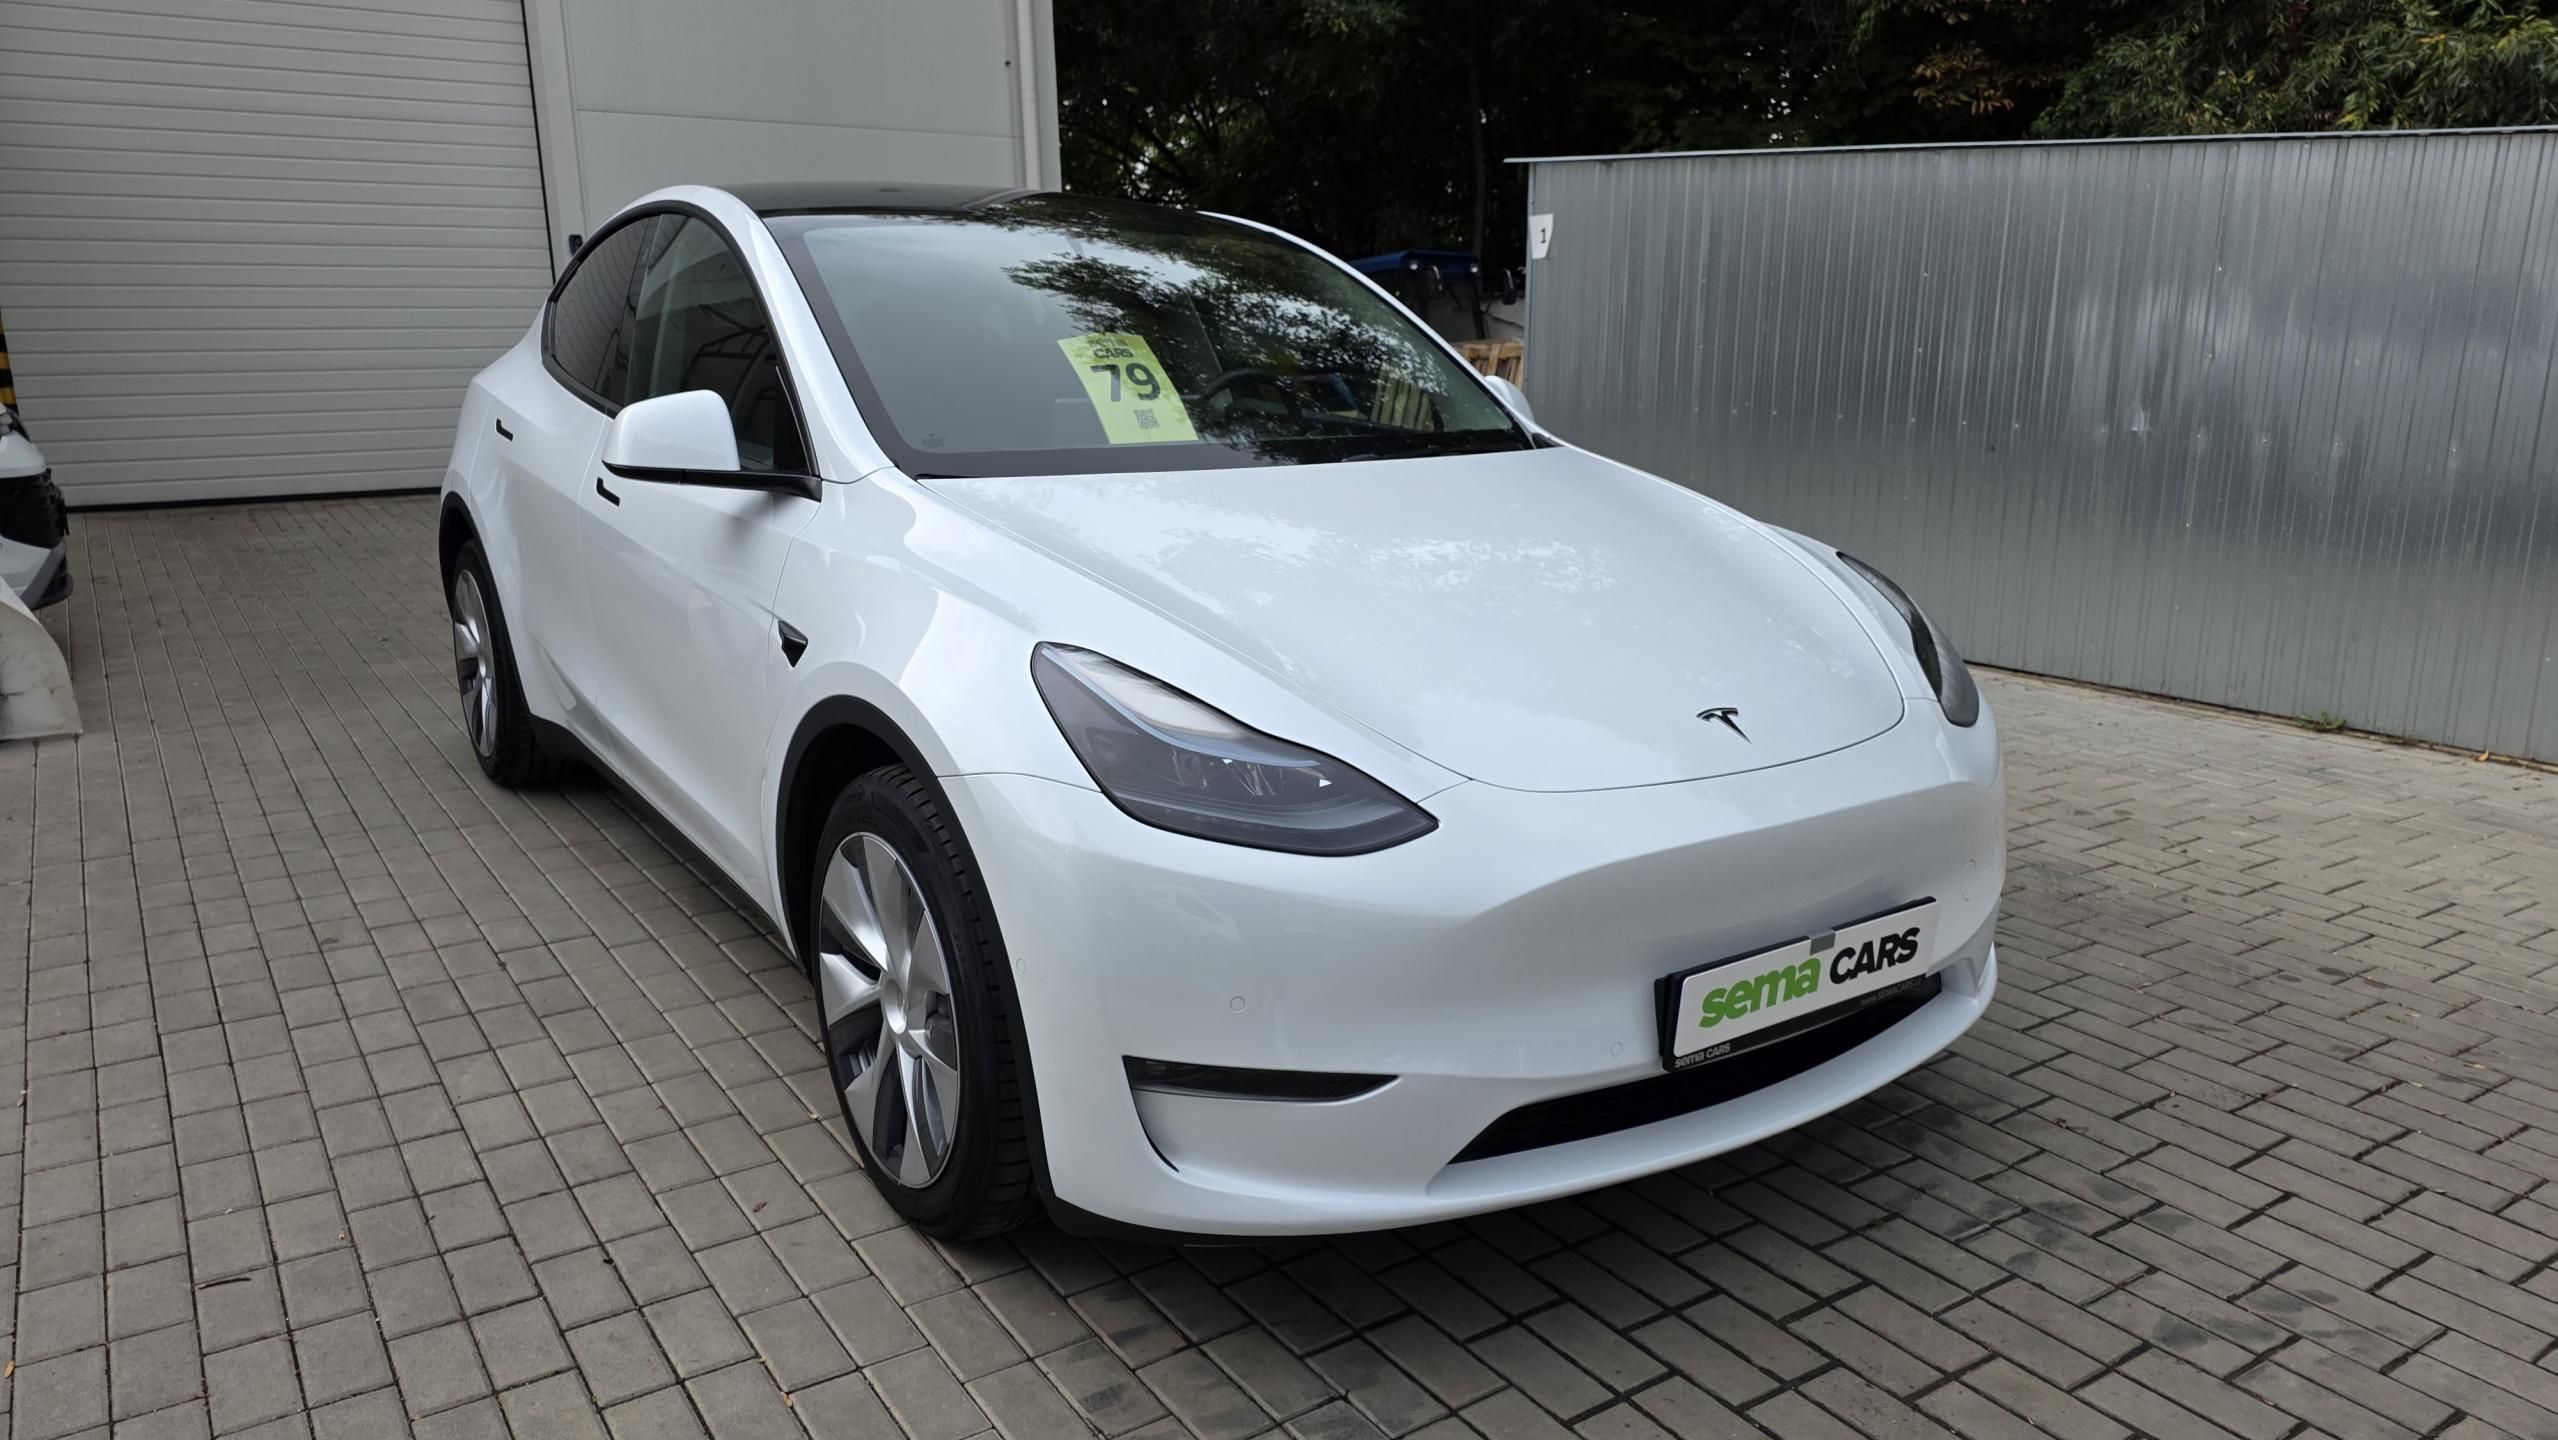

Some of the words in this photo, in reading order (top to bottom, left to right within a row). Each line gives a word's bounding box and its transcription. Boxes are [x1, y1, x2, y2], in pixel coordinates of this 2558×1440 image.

[1540, 227, 1546, 244] 1
[1093, 348, 1134, 359] CARS
[1090, 362, 1161, 403] 79
[1698, 957, 1822, 1029] sema
[1829, 927, 1921, 985] CARS
[1674, 1051, 1705, 1069] sema
[1706, 1042, 1731, 1059] CARS
